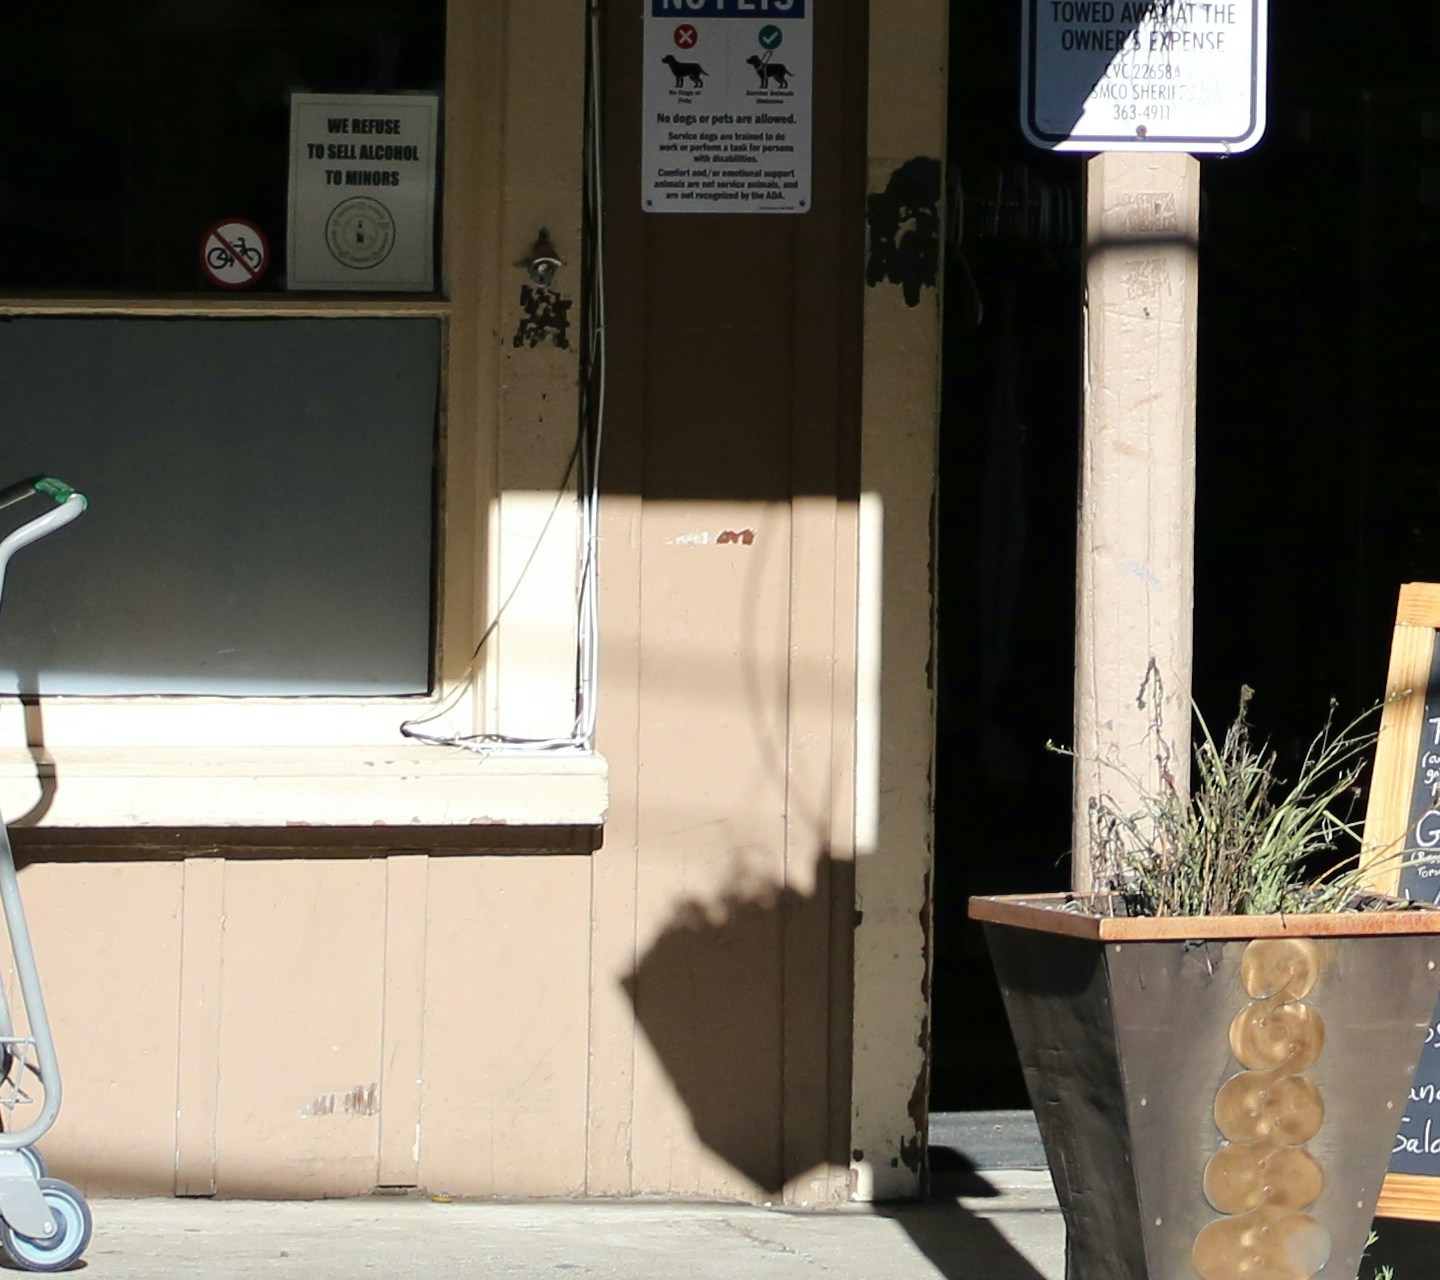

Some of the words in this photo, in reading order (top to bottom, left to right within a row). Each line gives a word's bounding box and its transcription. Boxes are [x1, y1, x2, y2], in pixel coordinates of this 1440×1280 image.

[1051, 1, 1117, 23] TOWED
[1121, 2, 1169, 24] AWAY
[1175, 3, 1196, 24] AT
[1205, 3, 1236, 24] THE
[1149, 31, 1226, 52] EXPENSE
[1105, 63, 1128, 80] CVC
[657, 113, 670, 124] No
[673, 113, 697, 126] dogs
[699, 115, 709, 124] or
[712, 114, 733, 126] pets
[736, 115, 752, 124] are
[755, 113, 797, 125] allowed.
[1113, 104, 1171, 121] 363-4911
[327, 118, 349, 134] WE
[352, 118, 401, 135] REFUSE
[668, 132, 697, 141] Service
[699, 132, 718, 142] dogs
[720, 133, 733, 141] are
[735, 132, 763, 141] trained
[765, 132, 773, 141] to
[307, 144, 326, 160] TO
[328, 144, 357, 160] SELL
[360, 145, 419, 161] ALCOHOL
[325, 170, 343, 185] TO
[345, 170, 400, 186] MINORS
